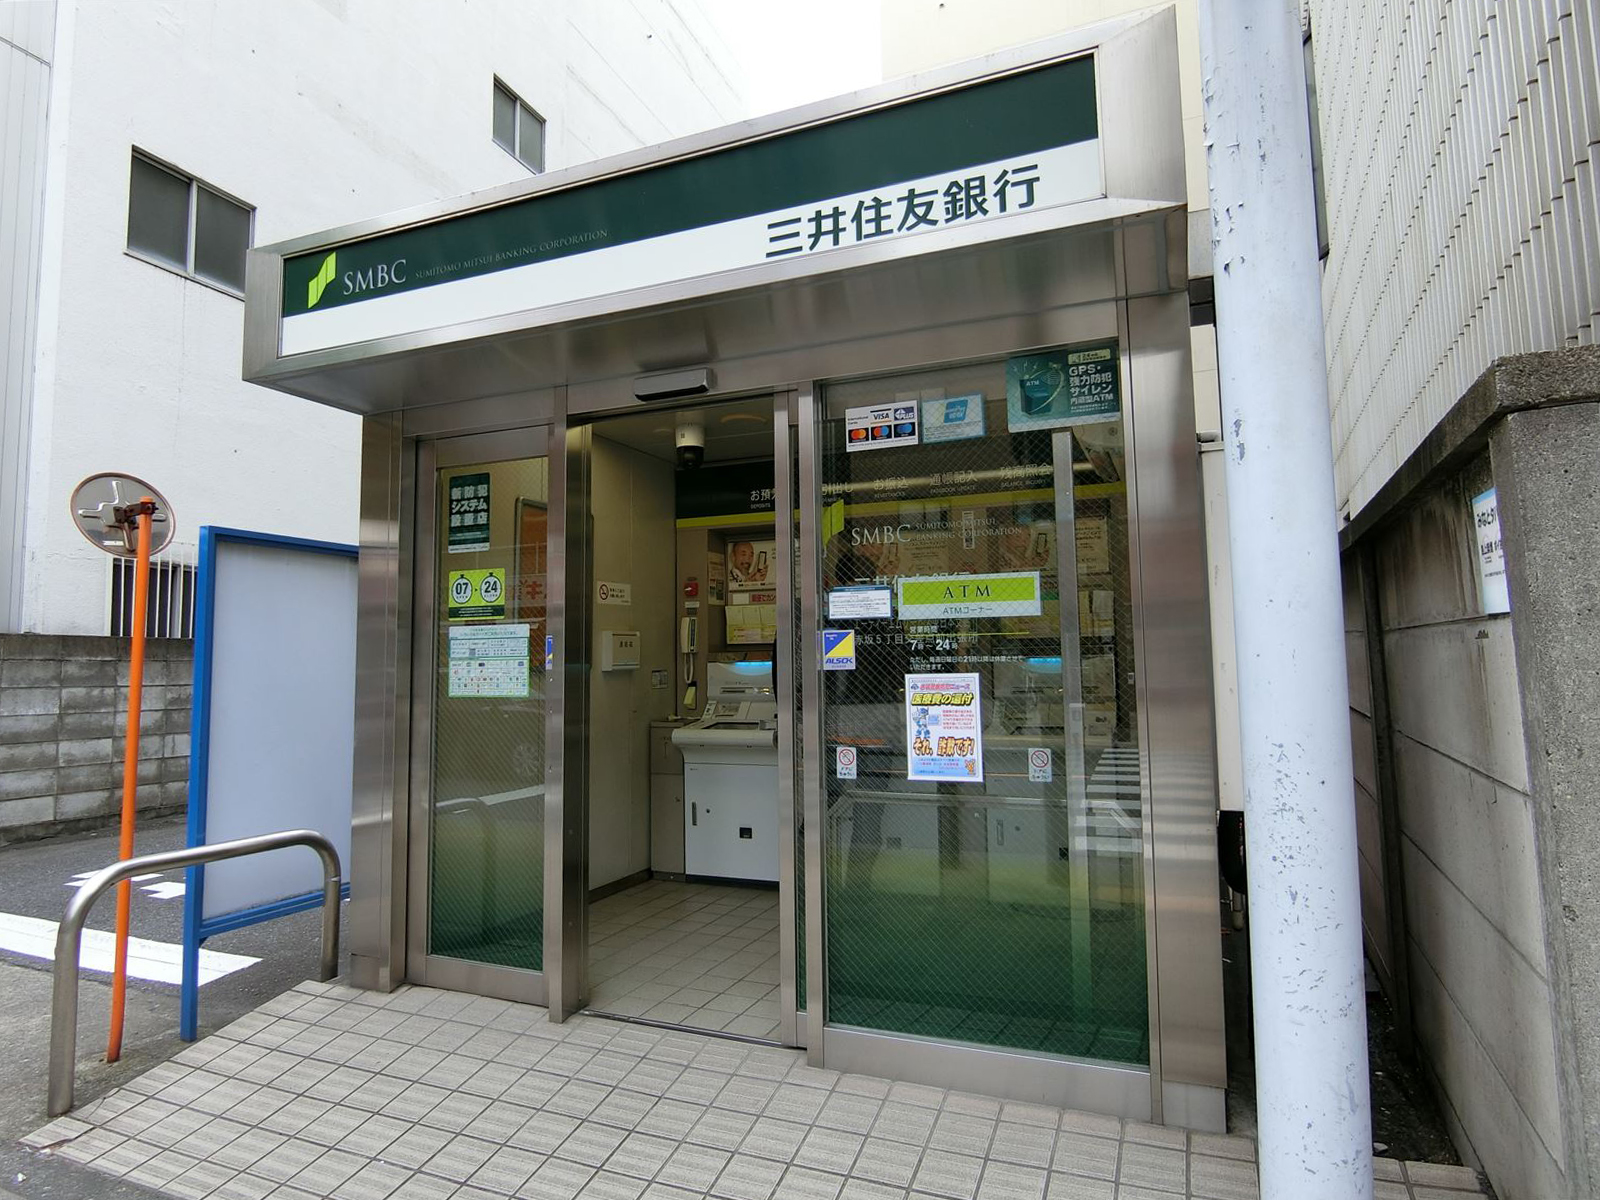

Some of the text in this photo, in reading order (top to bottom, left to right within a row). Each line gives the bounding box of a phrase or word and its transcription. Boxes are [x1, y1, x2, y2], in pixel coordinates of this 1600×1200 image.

[766, 164, 1040, 258] 三井住友銀行
[415, 230, 608, 279] SUMITOMO MITSUI BANKING CORPORATION
[343, 259, 407, 296] SMBC
[1069, 372, 1112, 387] 強力防犯
[1070, 384, 1112, 397] サイレン
[873, 412, 890, 420] VISA
[901, 412, 914, 420] PLUS
[873, 476, 909, 490] お振込
[930, 470, 977, 487] 通帳記入
[451, 484, 488, 500] 新防犯
[452, 498, 488, 513] システム
[450, 511, 488, 527] 設置店
[916, 521, 963, 531] SUMITOMO
[851, 524, 911, 546] SMBC
[916, 527, 1022, 540] BANKING CORPORATION
[455, 582, 469, 595] 07
[484, 580, 498, 593] 24
[943, 585, 992, 599] ATM
[942, 606, 993, 616] ATMコーナー
[909, 625, 938, 634] 営業時間
[911, 693, 974, 706] 医療費の還付
